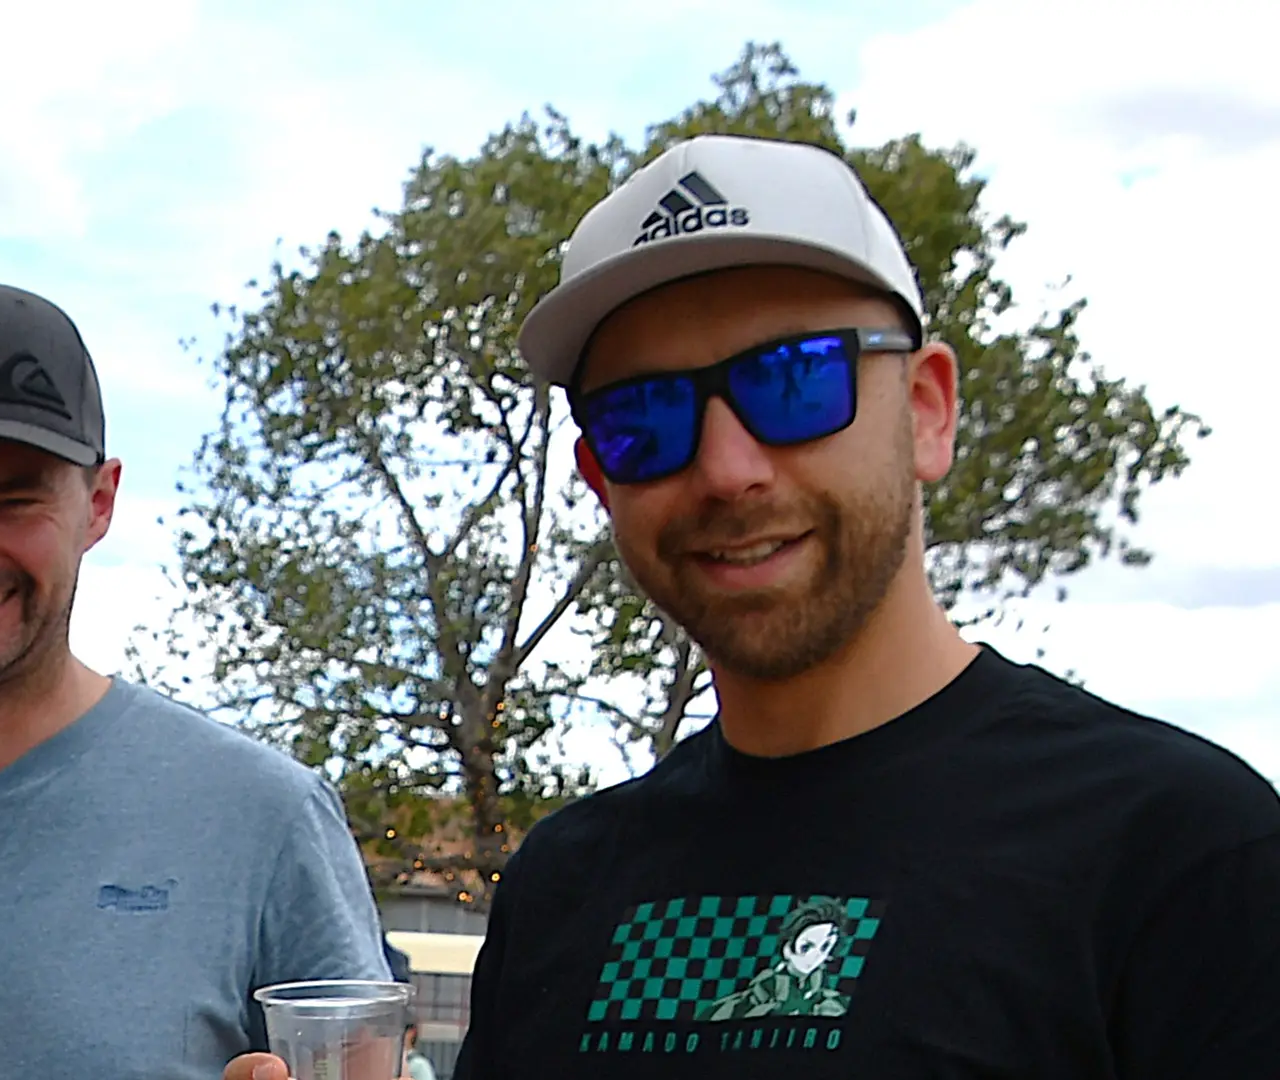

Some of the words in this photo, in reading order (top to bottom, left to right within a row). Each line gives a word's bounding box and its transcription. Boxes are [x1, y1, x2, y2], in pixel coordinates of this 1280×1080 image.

[632, 205, 750, 248] adidas
[578, 1031, 701, 1053] KAMADO
[719, 1028, 842, 1051] TANJIRO
